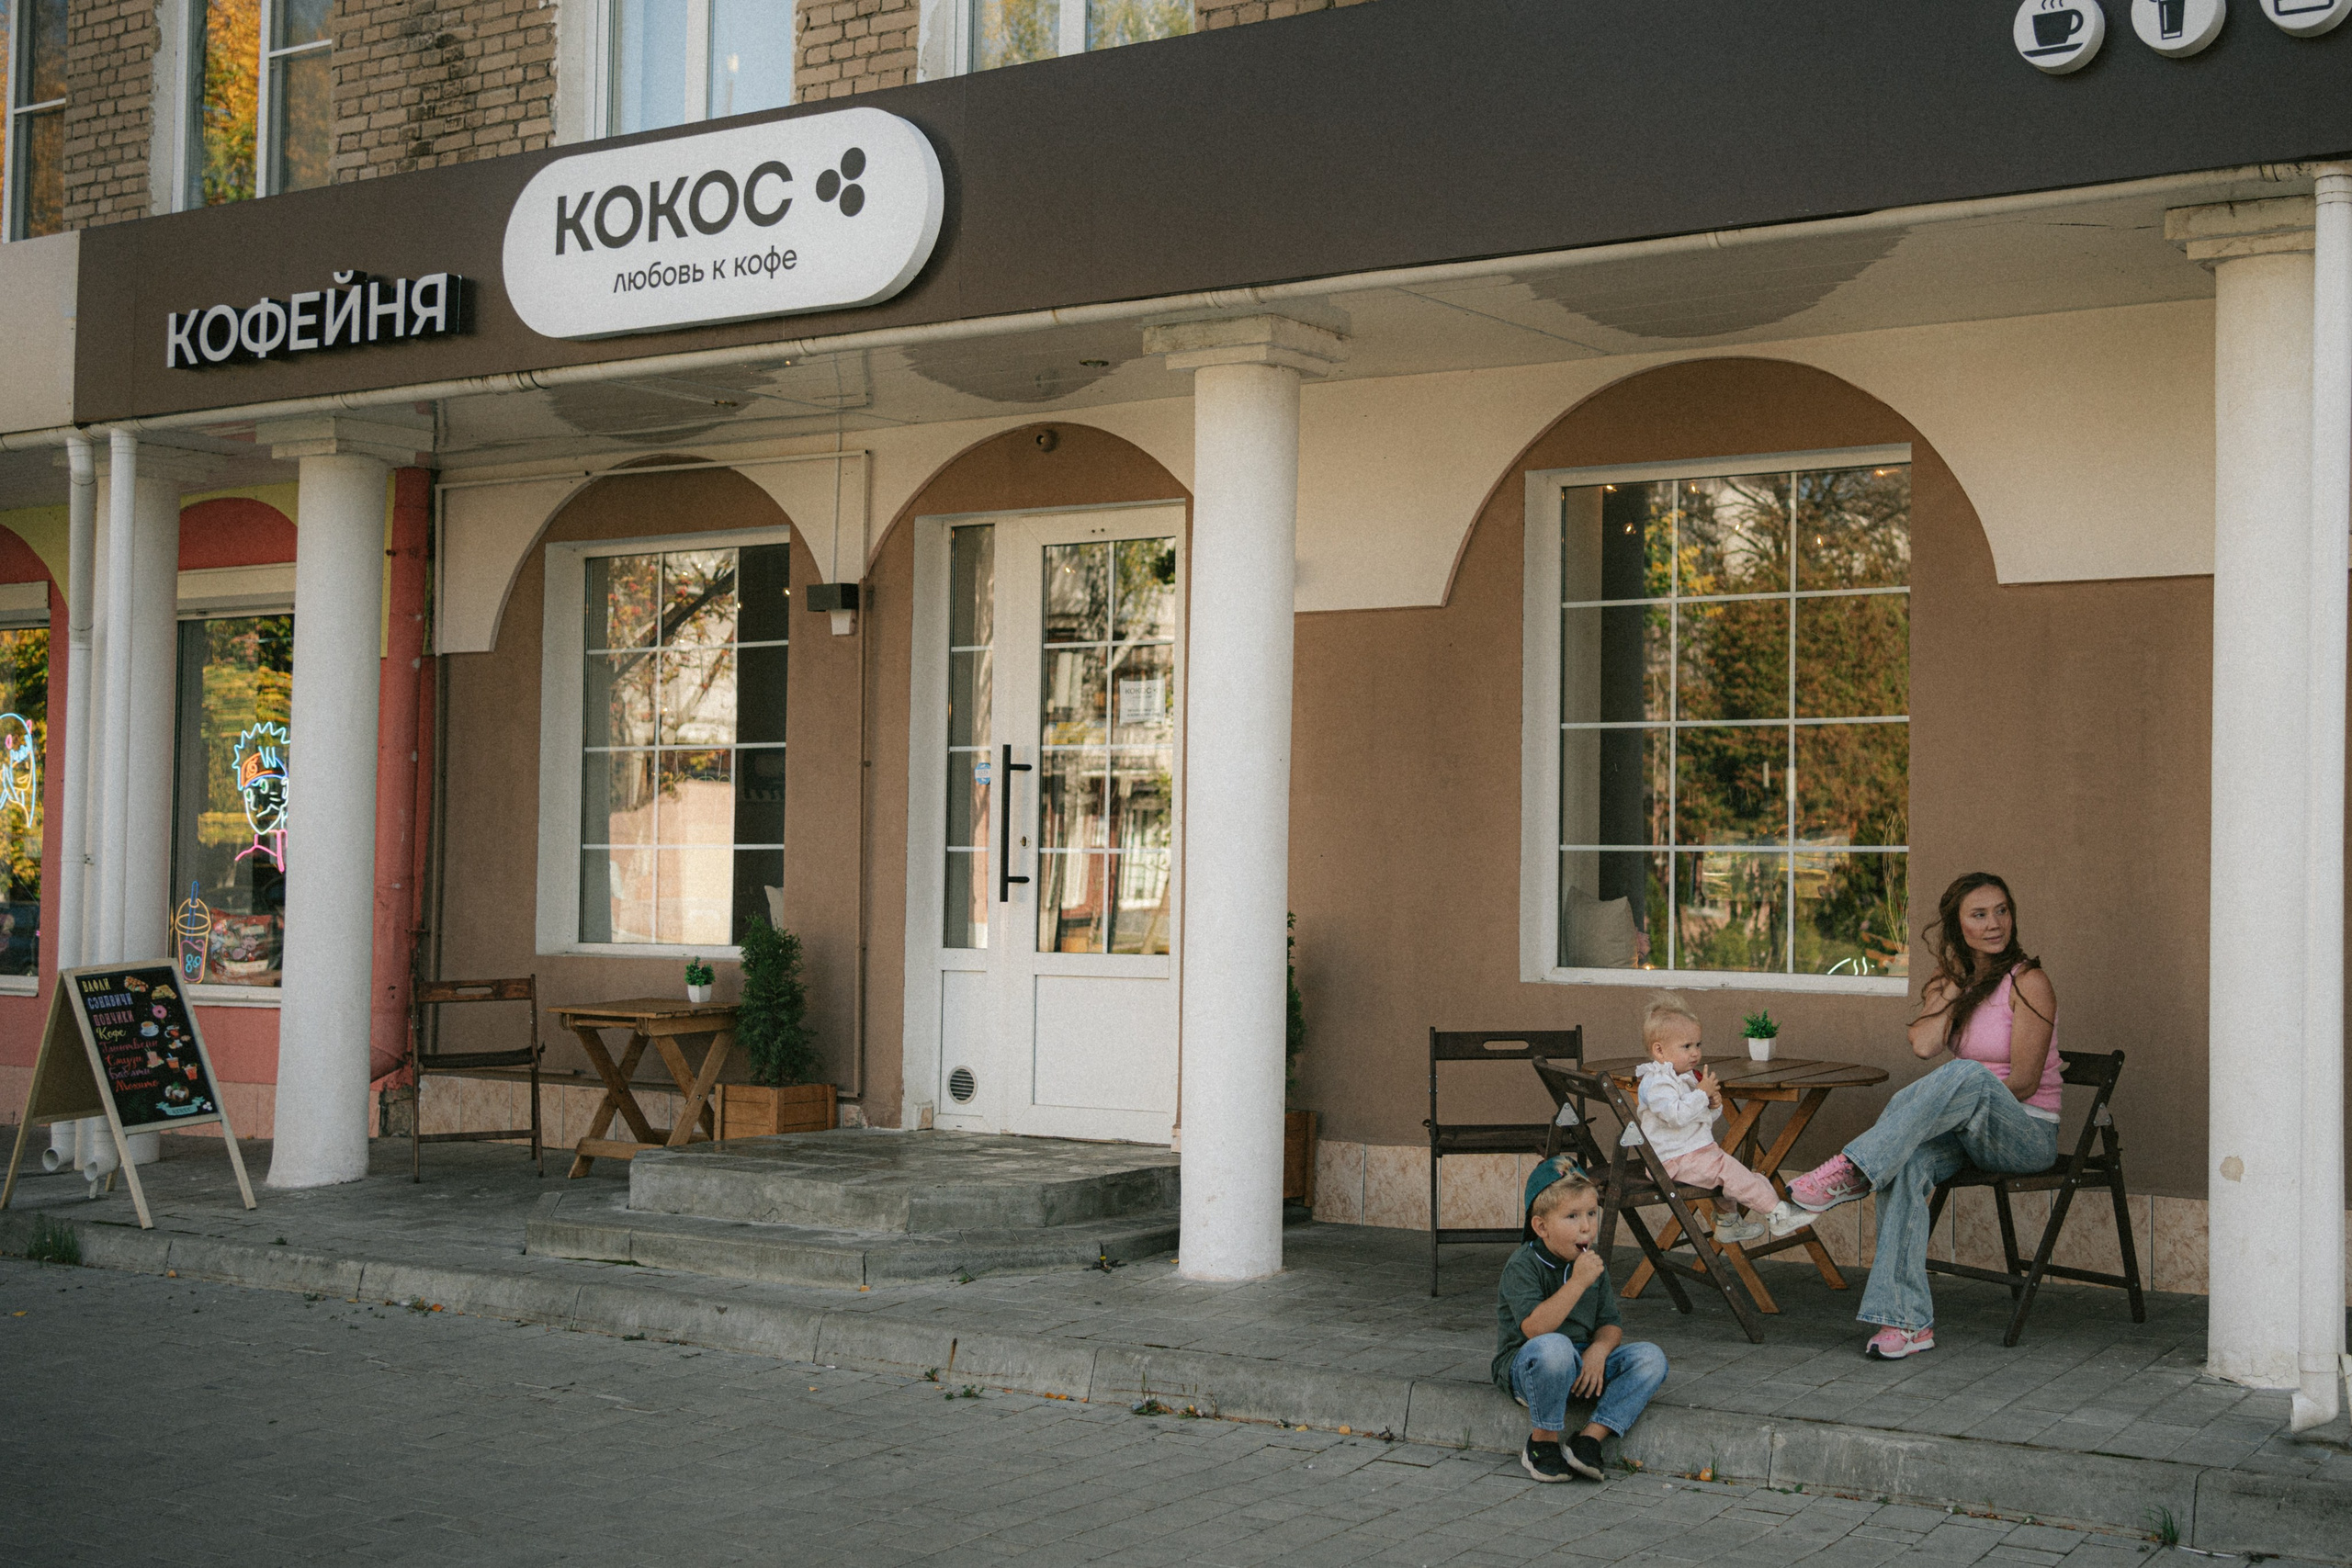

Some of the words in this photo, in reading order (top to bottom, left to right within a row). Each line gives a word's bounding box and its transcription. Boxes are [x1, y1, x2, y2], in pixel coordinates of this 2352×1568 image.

[555, 160, 793, 256] КОКОС
[613, 261, 706, 293] любовь
[711, 261, 727, 280] к
[732, 247, 798, 278] кофе
[166, 268, 448, 368] КОФЕЙНЯ
[82, 978, 110, 992] ВАФЛИ
[87, 993, 133, 1010] СЭНДВИЧИ
[93, 1010, 134, 1026] ПОНЧИКИ
[96, 1027, 126, 1042] Кофе
